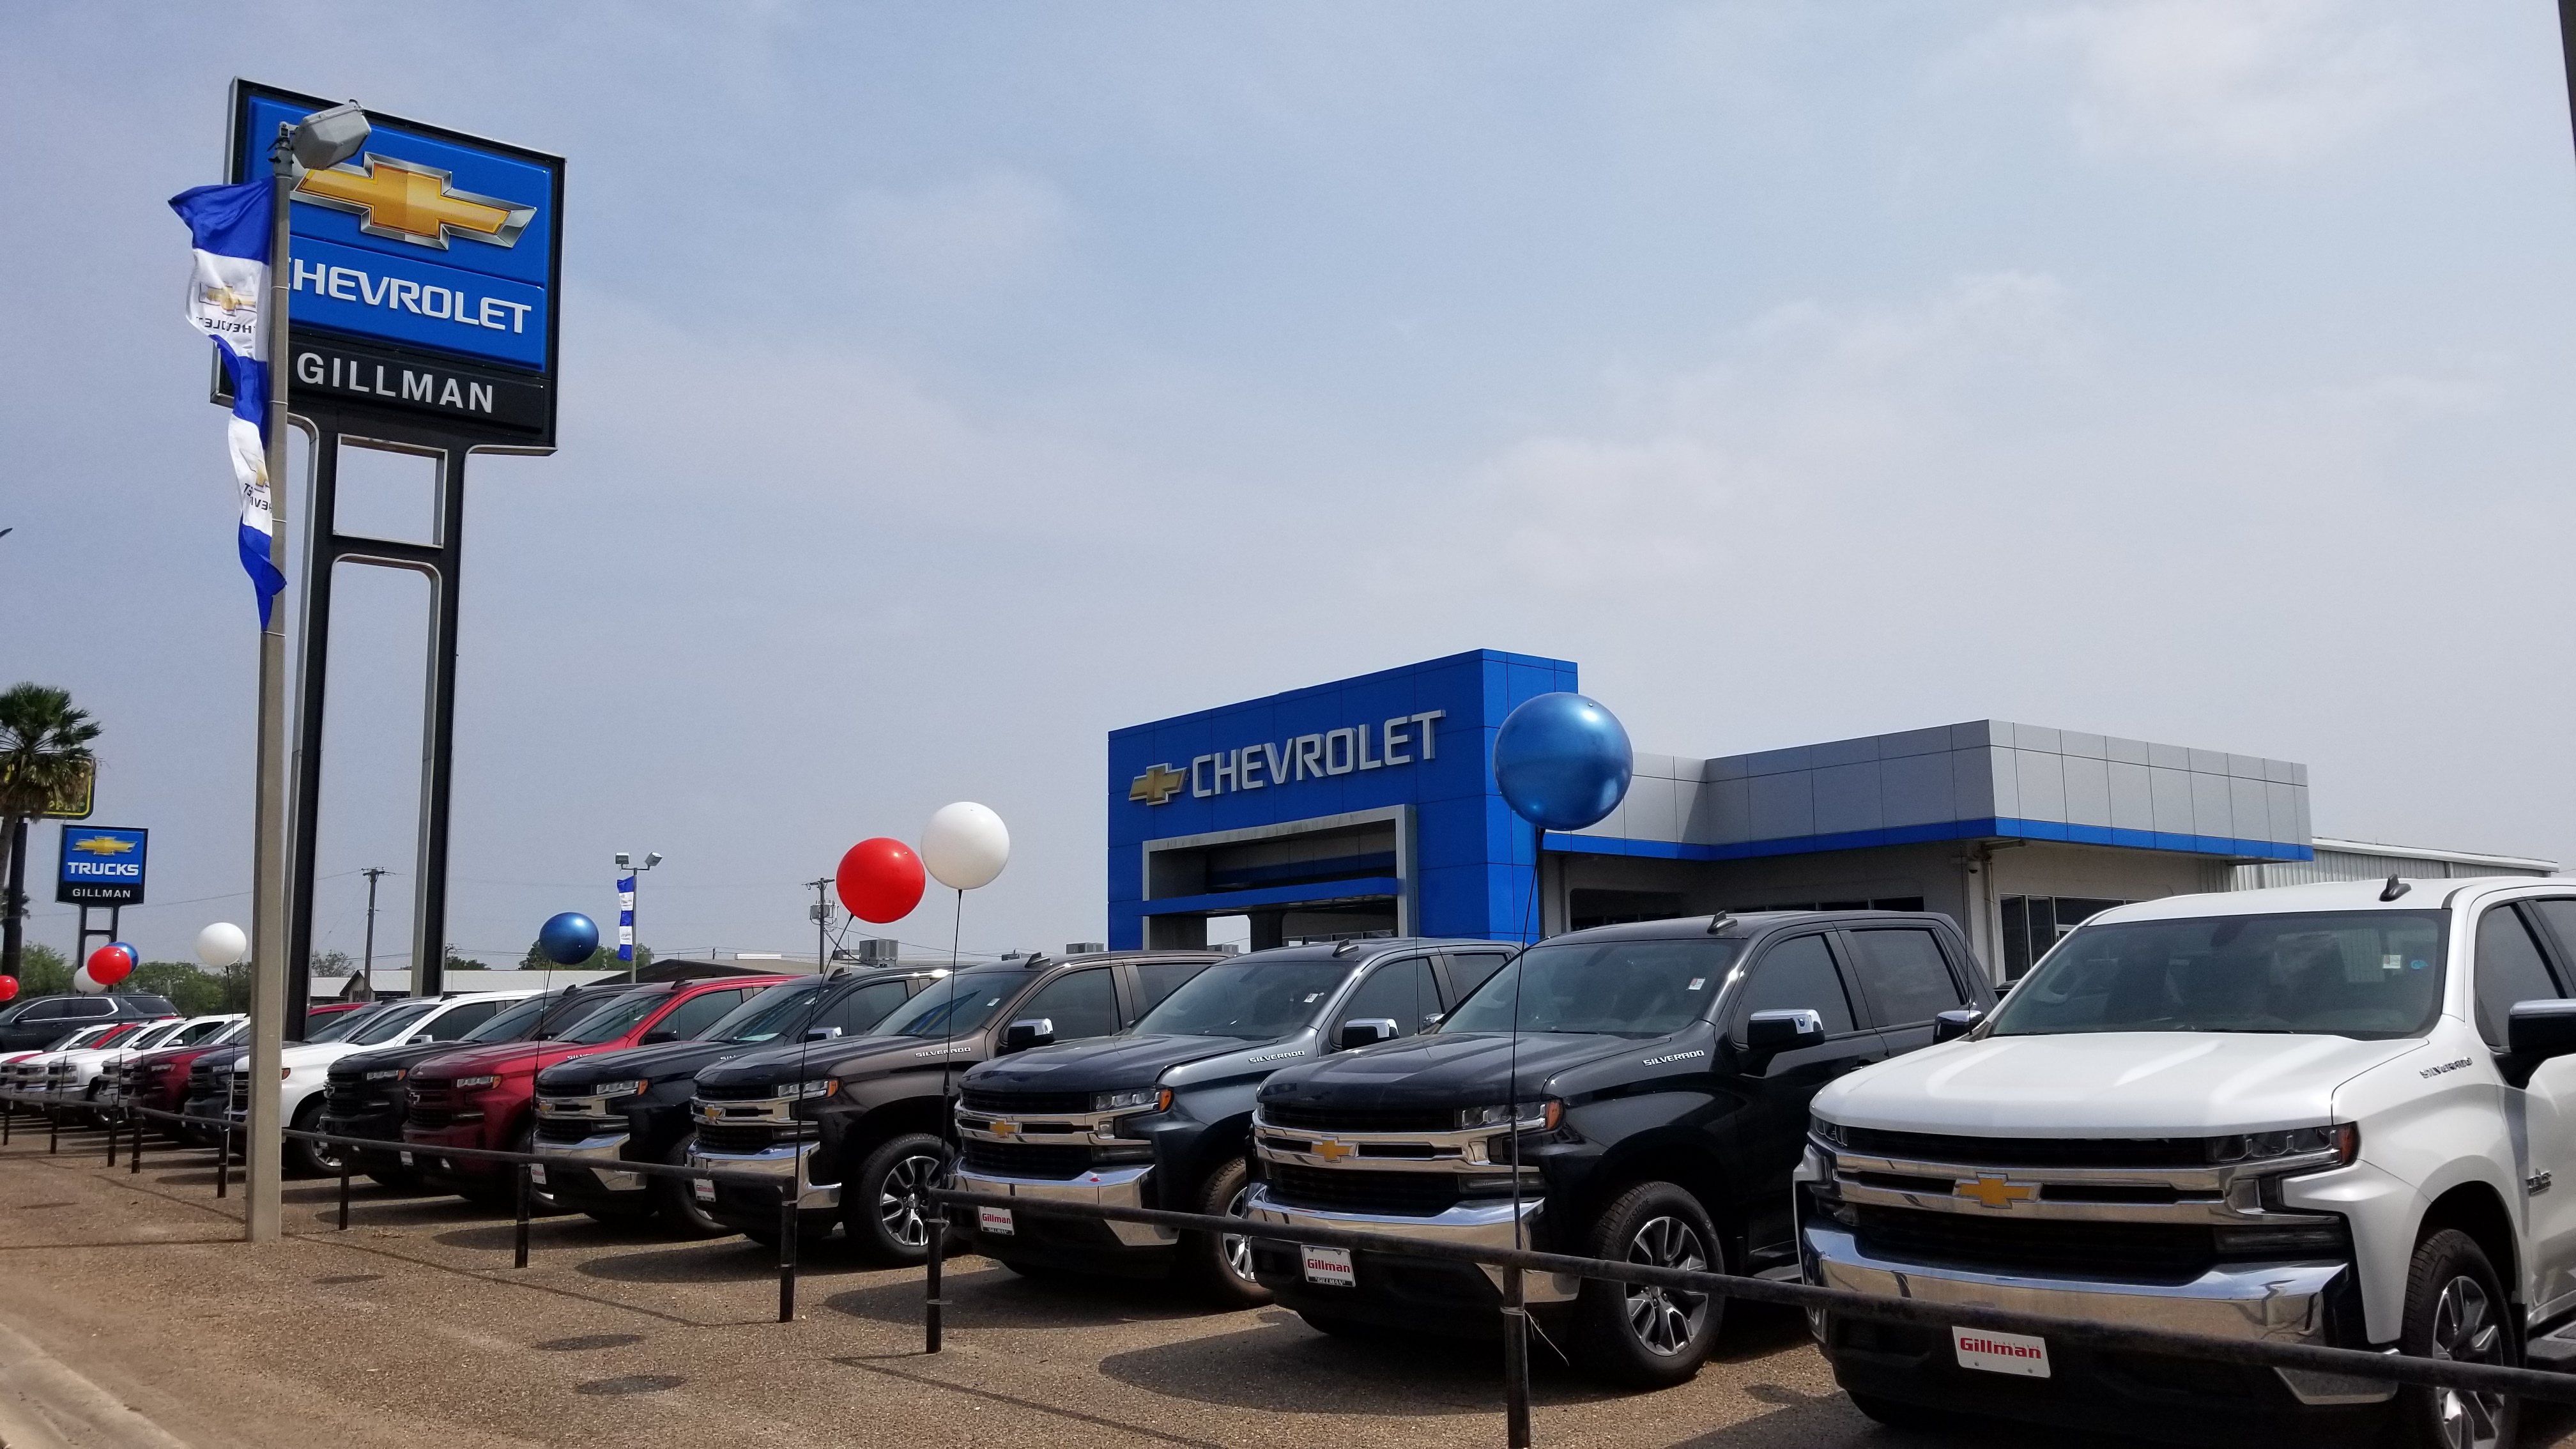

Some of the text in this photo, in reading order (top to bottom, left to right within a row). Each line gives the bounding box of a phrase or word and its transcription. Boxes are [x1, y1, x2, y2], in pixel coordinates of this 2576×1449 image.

[289, 257, 532, 334] HEVROLET
[296, 352, 493, 414] GILLMAN
[1192, 709, 1446, 798] CHEVROLET
[68, 862, 139, 876] TRUCKS
[72, 889, 131, 898] GILLMAN
[915, 1047, 971, 1058] SILVERADO
[1248, 1050, 1305, 1064] SILVERADO
[1642, 1050, 1705, 1066] SILVERADO
[982, 1213, 1011, 1225] Gillman
[1307, 1259, 1351, 1273] Gillman
[1960, 1337, 2041, 1360] Gillman
